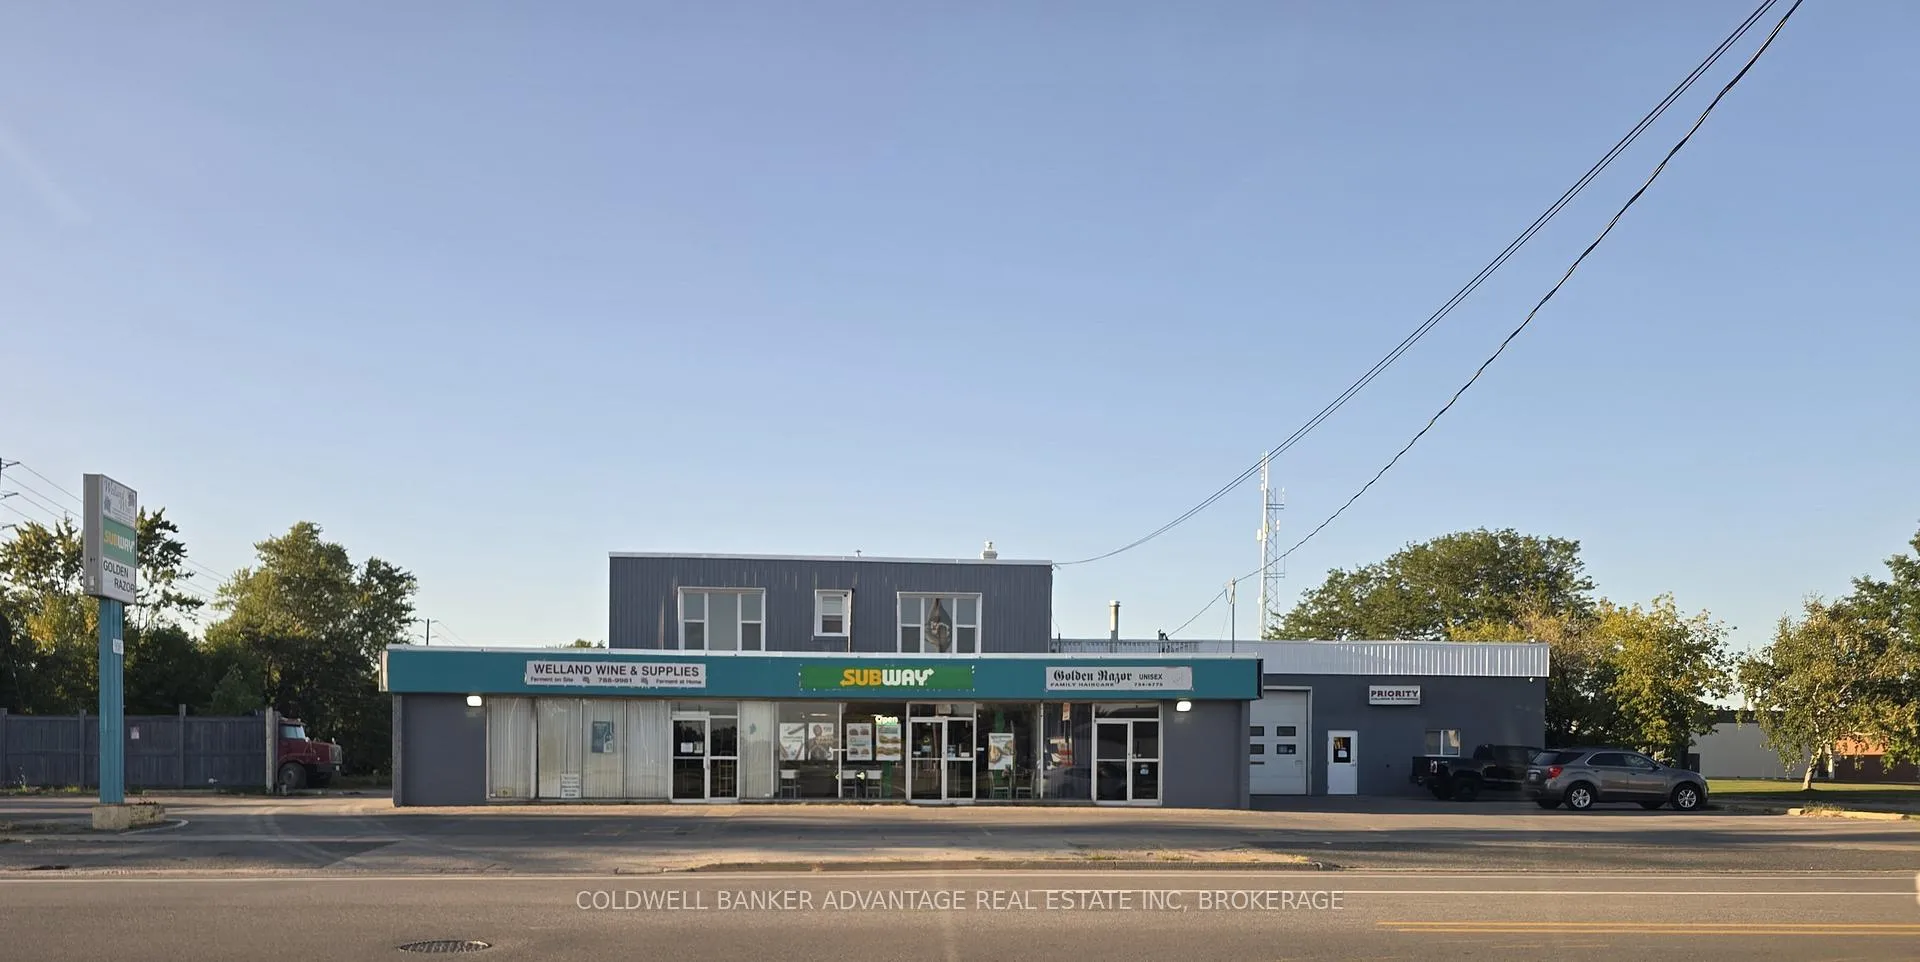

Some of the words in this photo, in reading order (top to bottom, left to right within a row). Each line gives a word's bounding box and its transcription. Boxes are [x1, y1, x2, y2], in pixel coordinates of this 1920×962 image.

[104, 529, 135, 553] SUBWAY
[103, 560, 129, 579] GOLDEN
[114, 577, 135, 594] RAZOR
[534, 663, 592, 675] WELLAND
[595, 664, 627, 675] WINE
[630, 665, 638, 676] &
[641, 665, 700, 677] SUPPLIES
[839, 668, 935, 687] SUBWAY
[1053, 669, 1094, 681] Golden
[1097, 669, 1133, 684] Razor
[1139, 672, 1163, 681] UNISEX
[874, 714, 899, 725] Open
